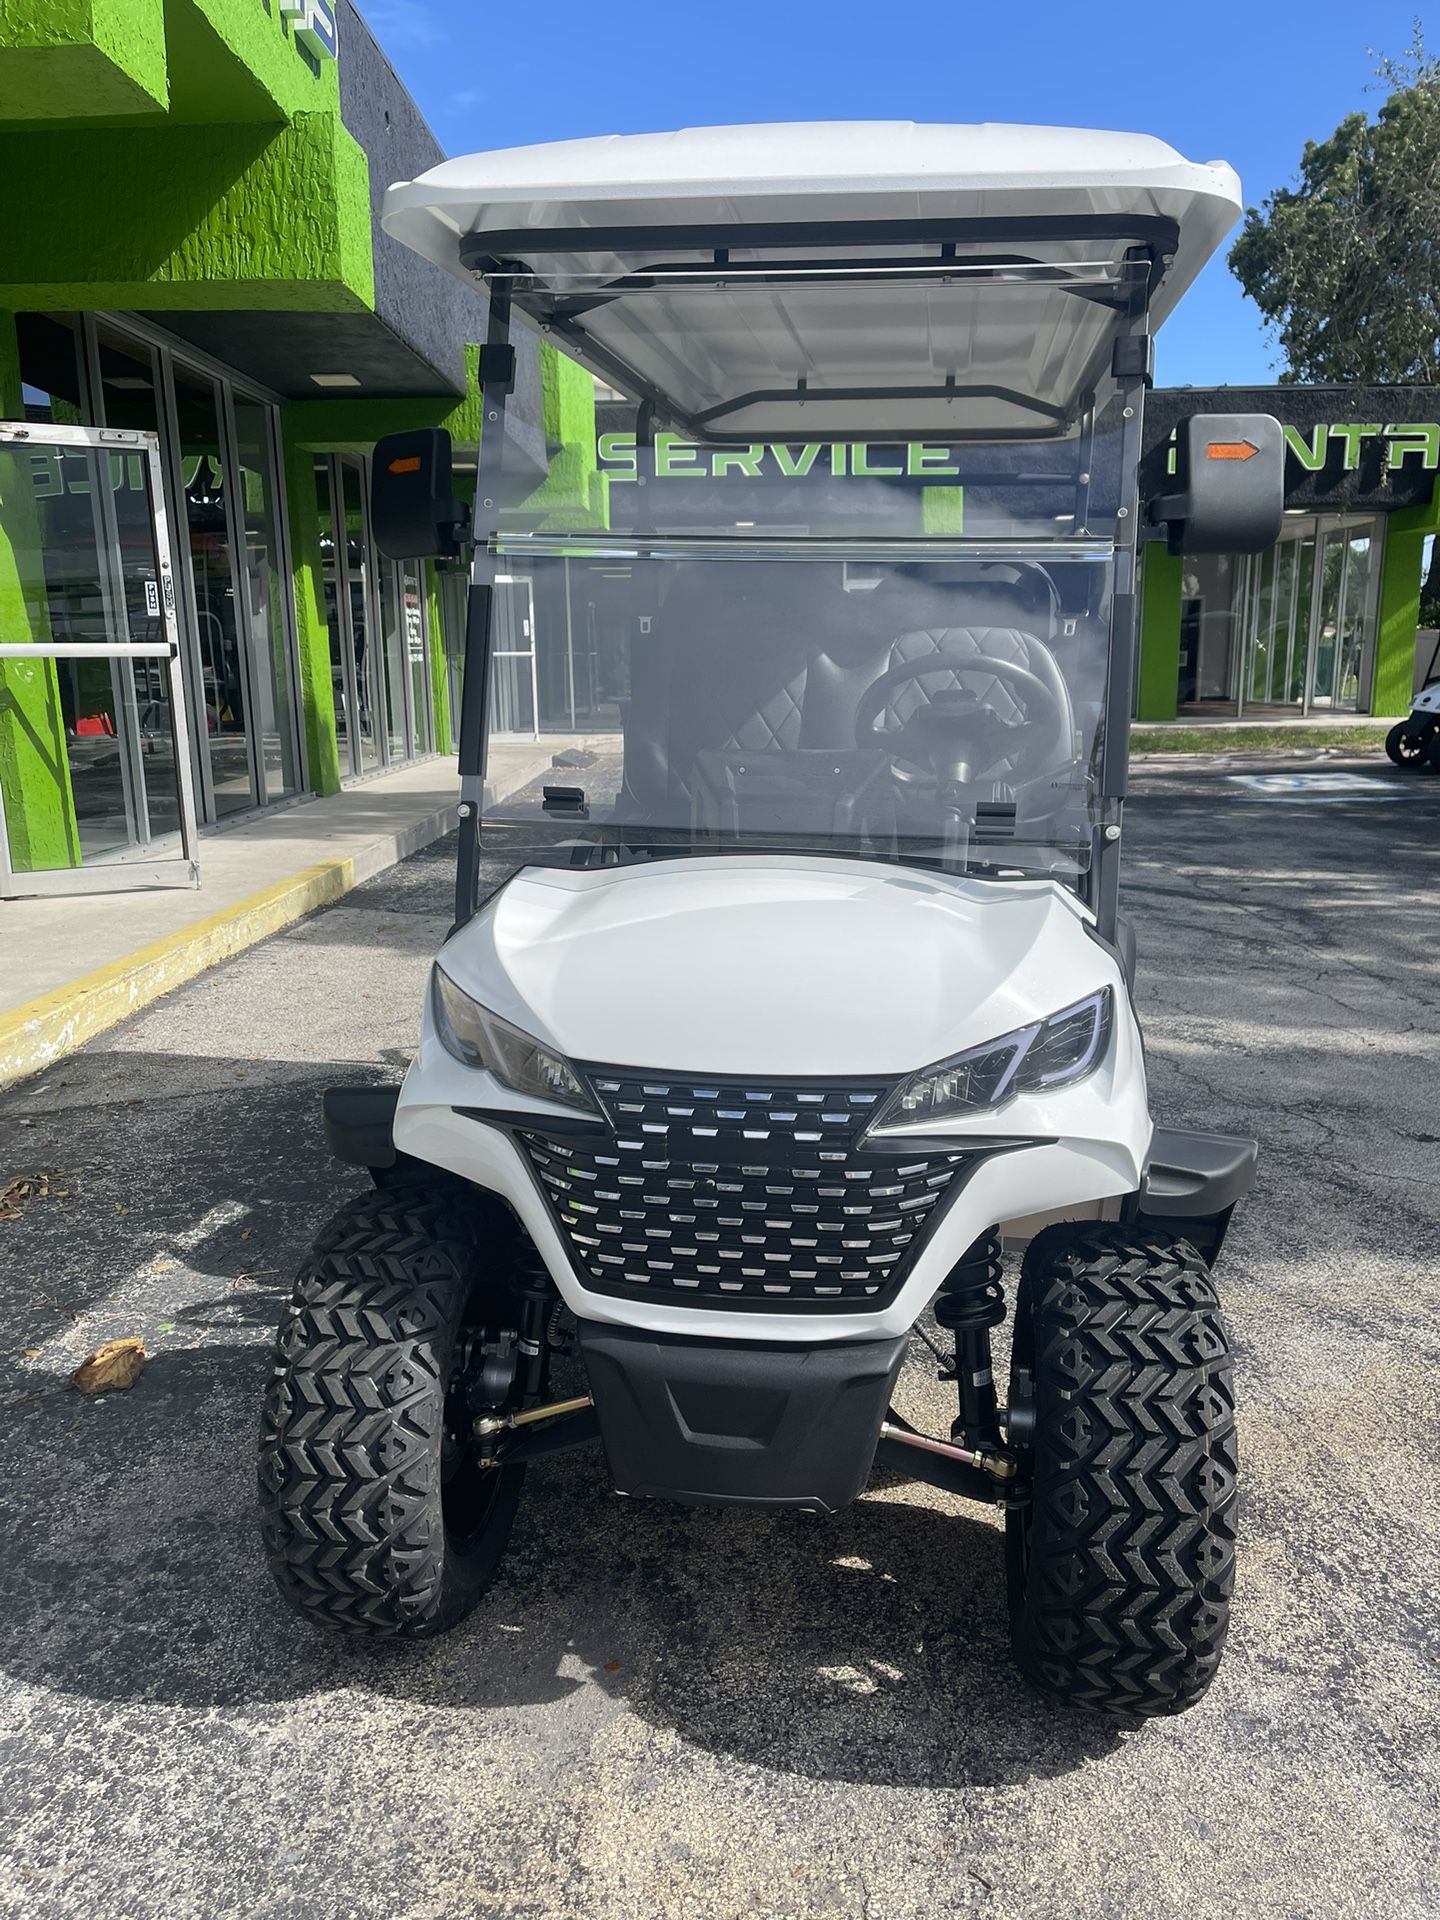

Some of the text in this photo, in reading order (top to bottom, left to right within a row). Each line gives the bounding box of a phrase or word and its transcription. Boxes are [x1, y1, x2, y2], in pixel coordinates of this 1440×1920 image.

[597, 432, 960, 481] SERVICE
[148, 584, 156, 608] PUSH
[163, 576, 173, 606] PUSH
